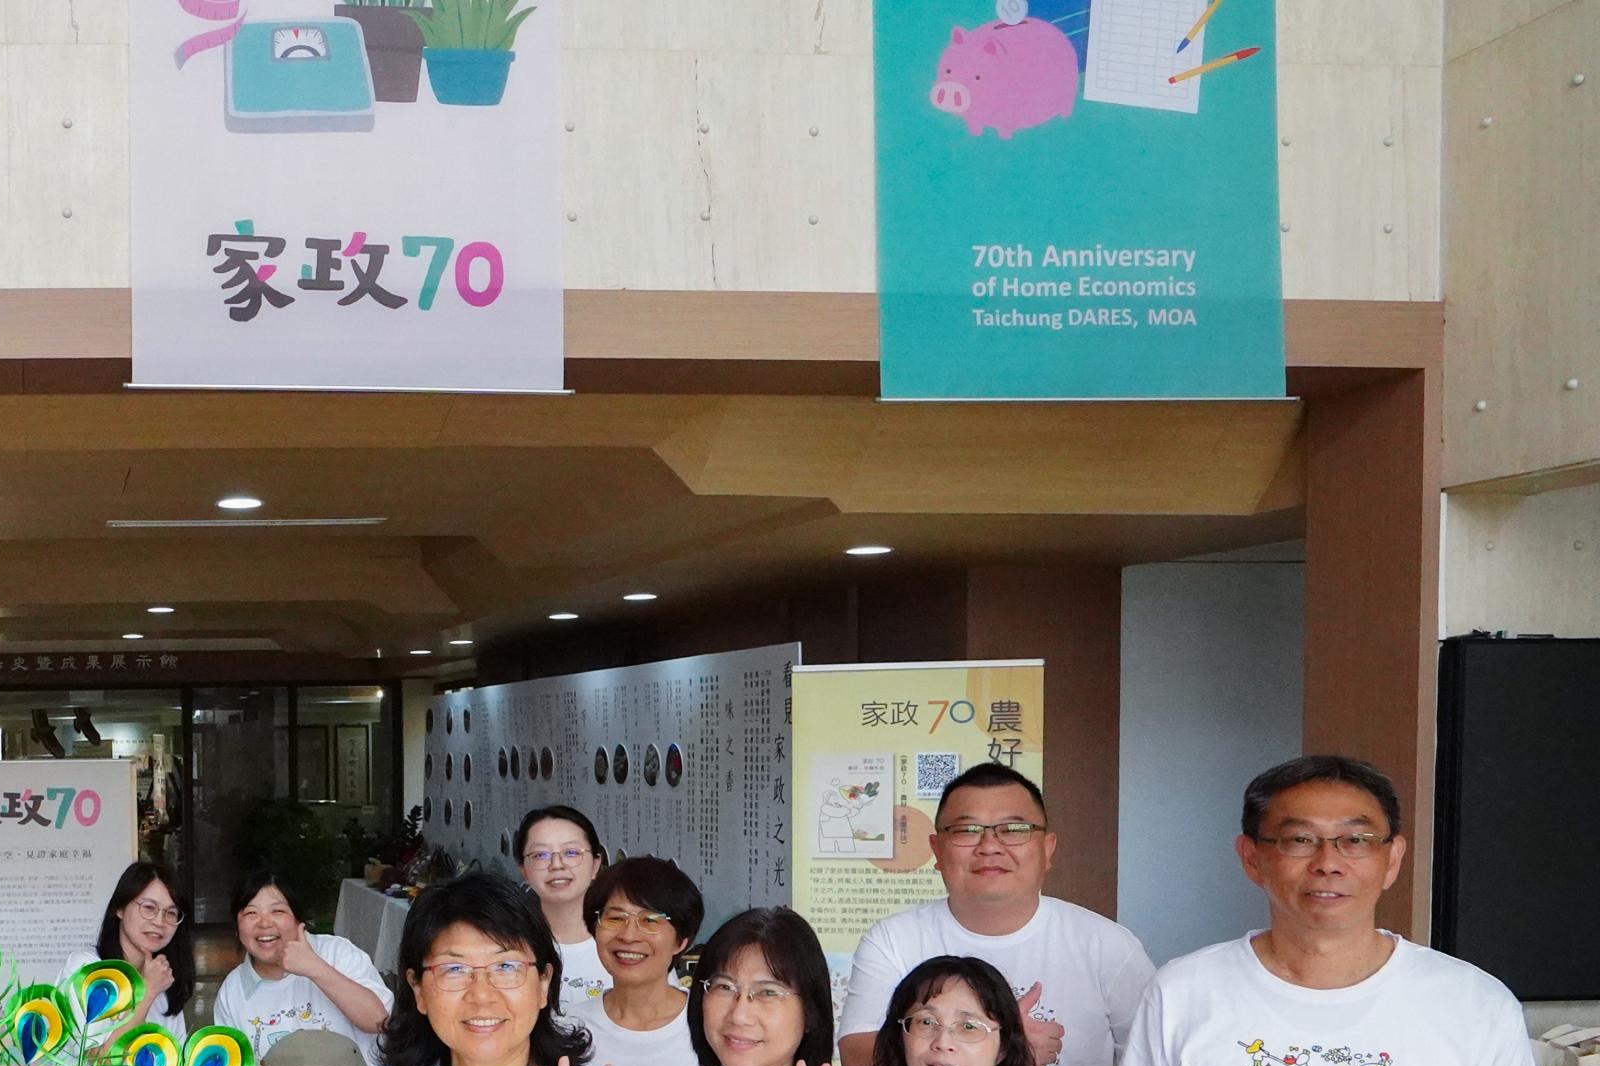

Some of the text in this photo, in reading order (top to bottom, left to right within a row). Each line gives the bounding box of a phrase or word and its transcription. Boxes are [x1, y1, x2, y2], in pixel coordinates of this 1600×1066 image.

[972, 244, 1196, 271] 70th Anniversary
[206, 219, 504, 322] 家政70
[972, 276, 1196, 297] of Home Economics
[972, 308, 1197, 330] Taichung DARES, MOA
